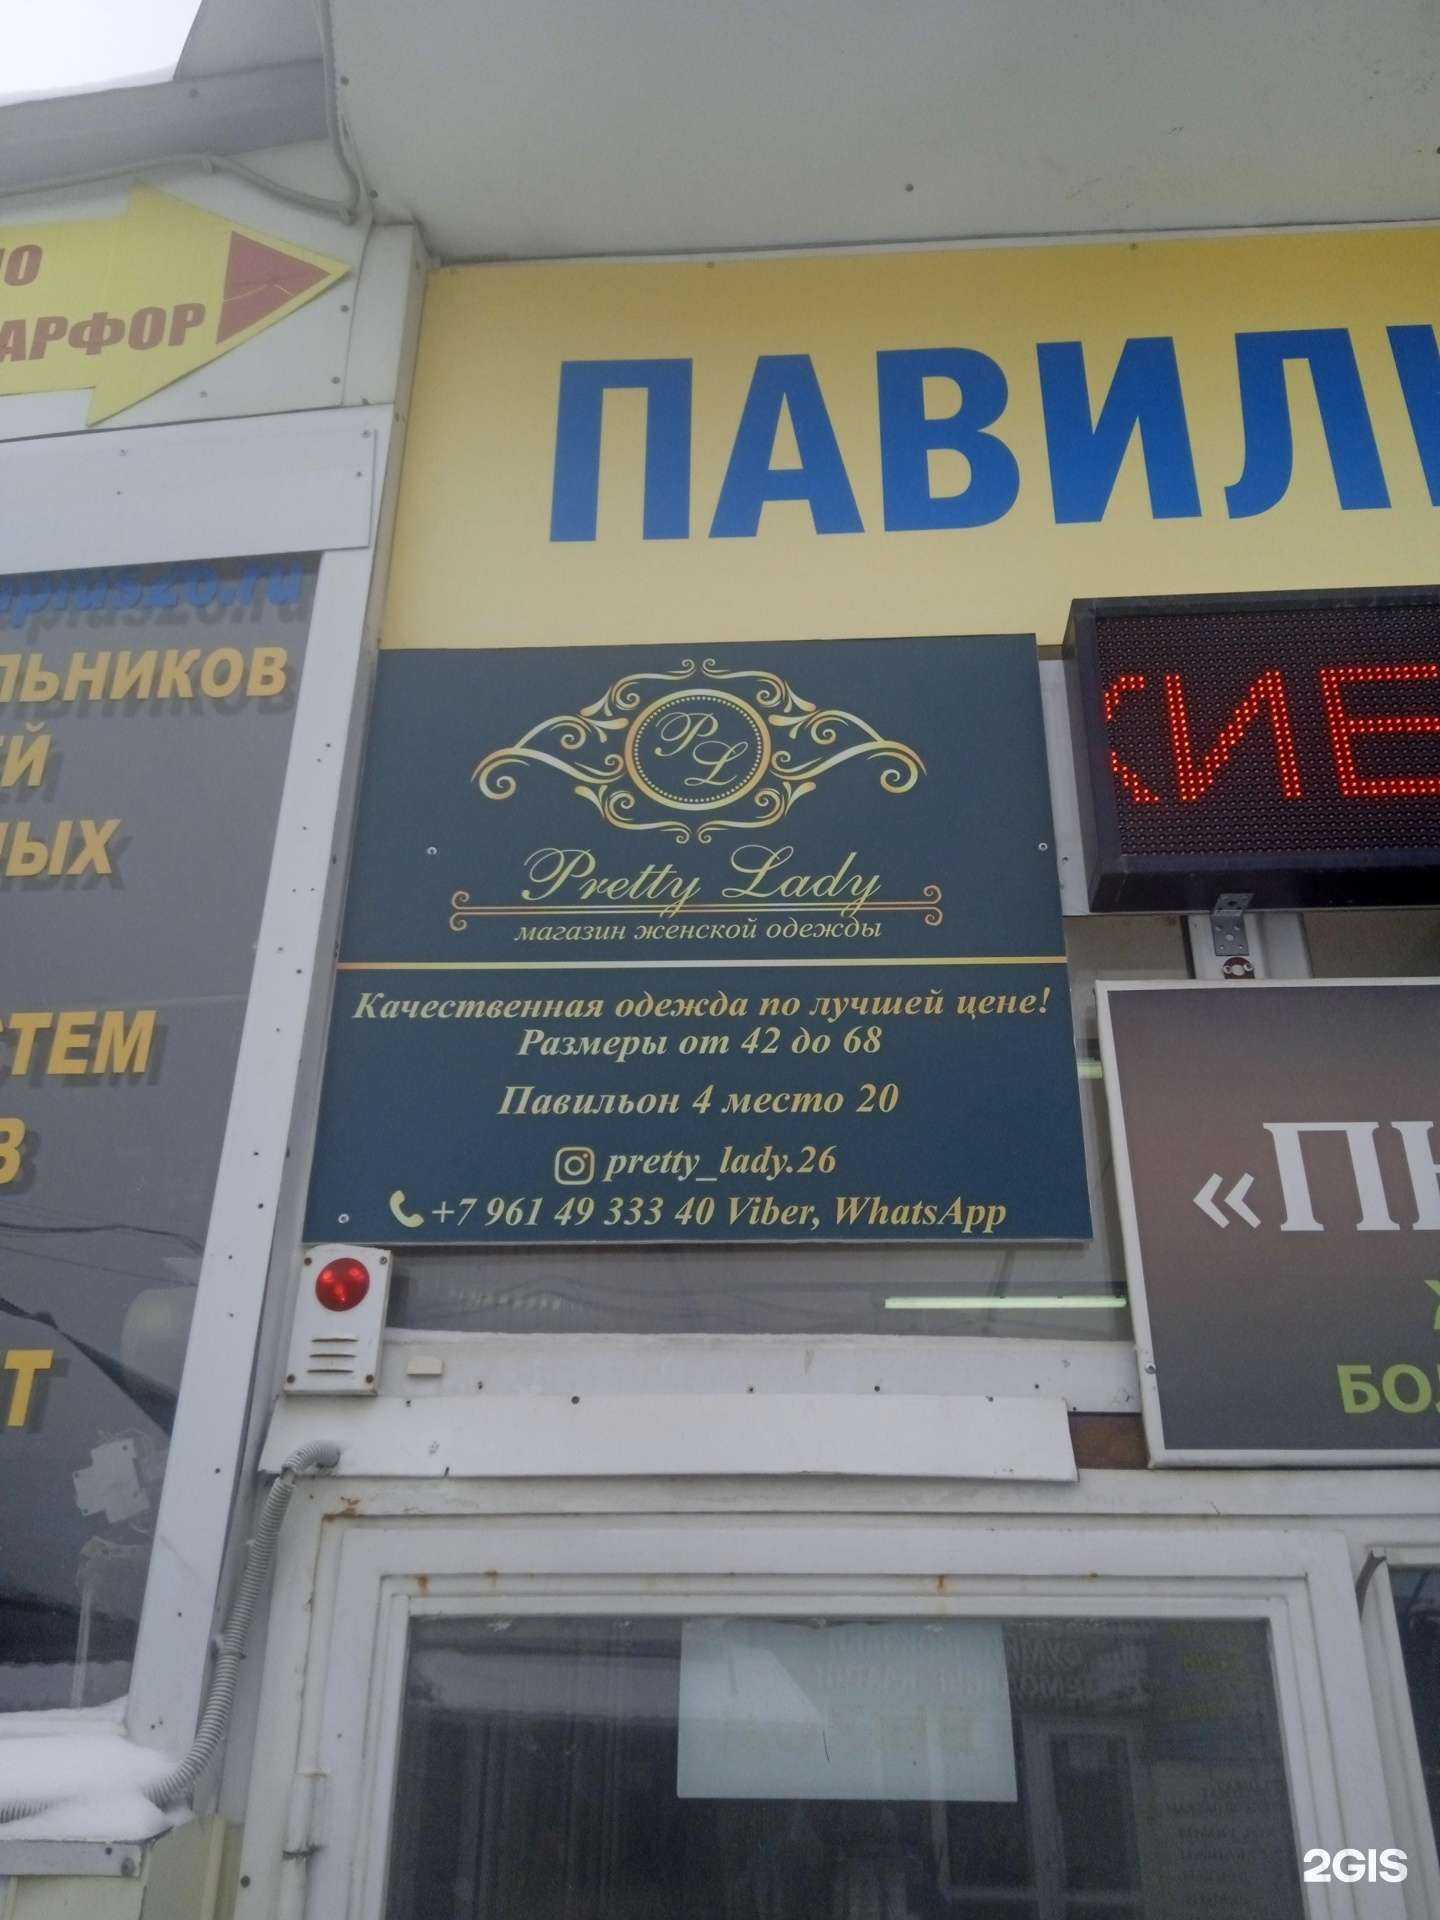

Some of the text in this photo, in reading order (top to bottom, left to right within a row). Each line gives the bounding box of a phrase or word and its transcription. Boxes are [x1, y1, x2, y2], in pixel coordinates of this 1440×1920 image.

[0, 245, 43, 286] О
[0, 721, 52, 788] Й
[520, 844, 882, 919] Pretty Lady
[513, 917, 882, 942] магазин женской одежды
[352, 987, 1051, 1023] Качественная одежда по лучшей цене!
[0, 1010, 156, 1075] ТЕМ
[517, 1026, 882, 1063] Размеры от 42 до 68
[496, 1083, 899, 1115] Павильон 4 место 20
[602, 1146, 837, 1182] pretty_lady.26
[432, 1196, 1006, 1234] +7 961 49 333 40 Viber, WhatsApp
[1337, 1364, 1440, 1414] БО
